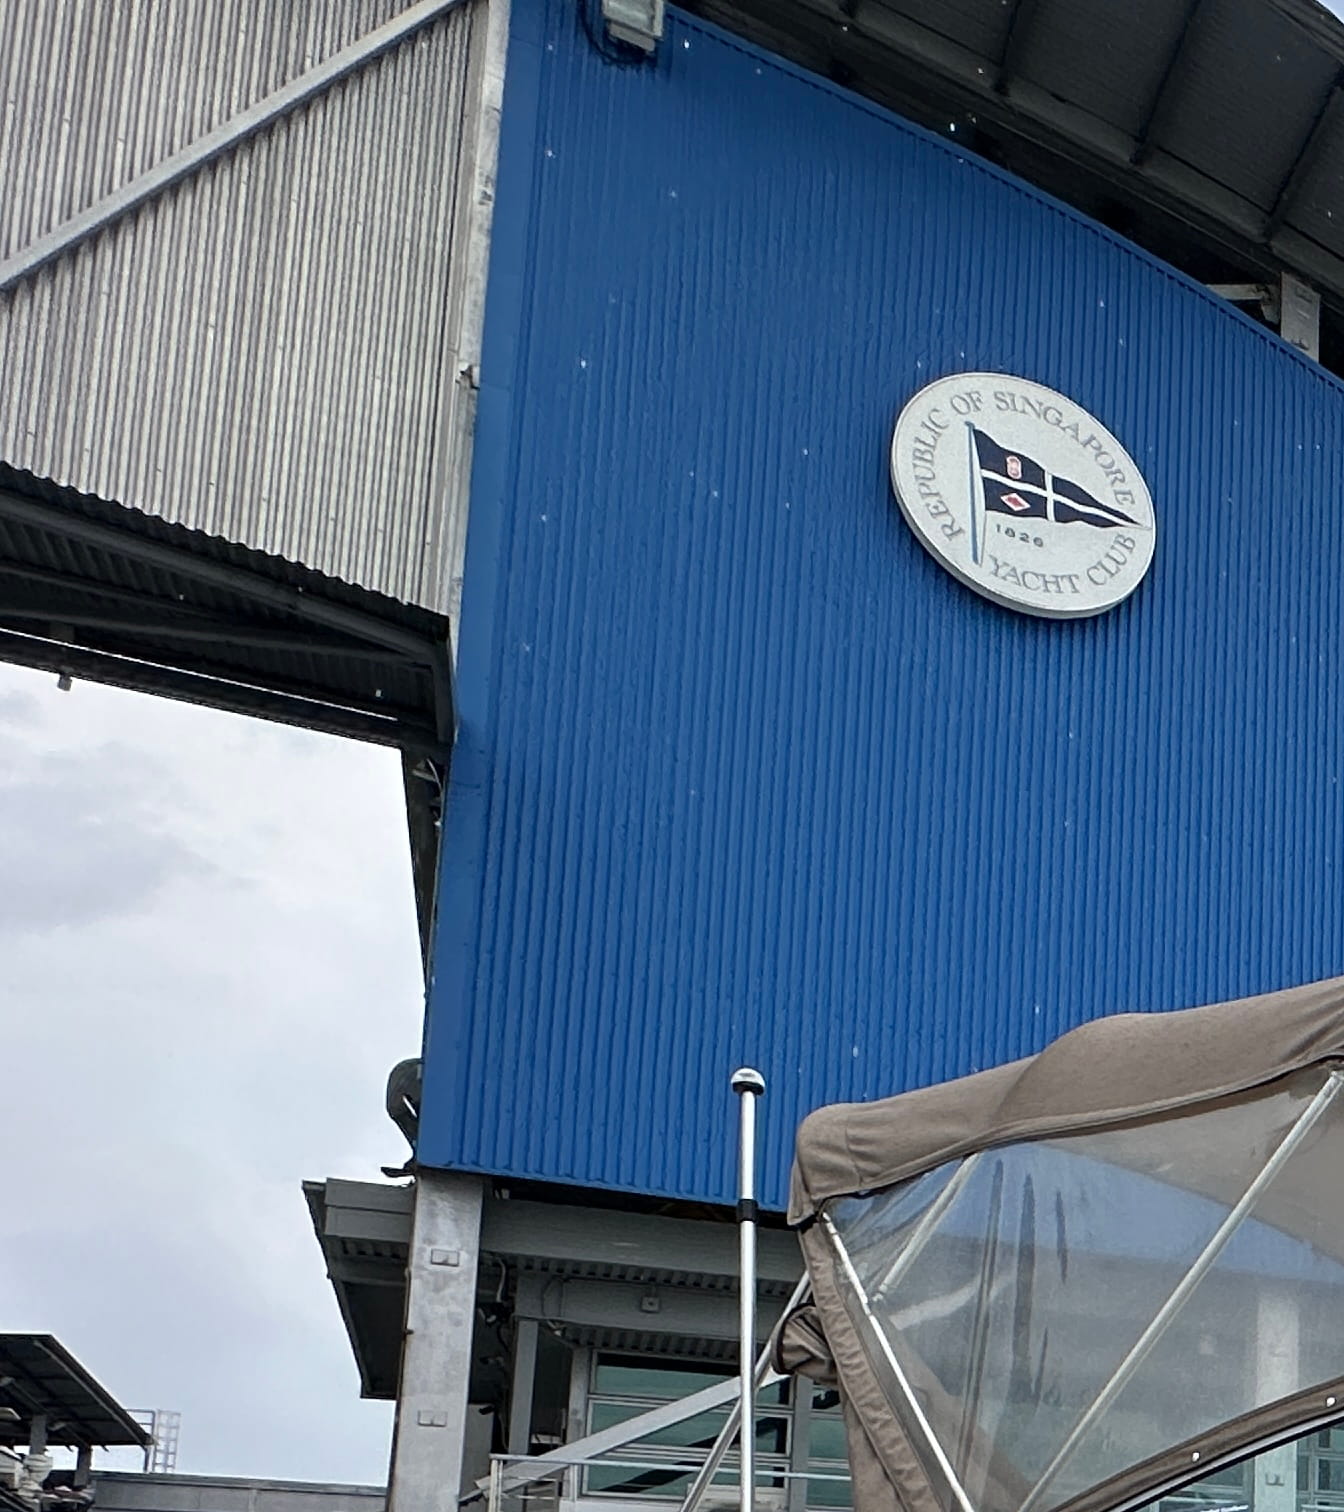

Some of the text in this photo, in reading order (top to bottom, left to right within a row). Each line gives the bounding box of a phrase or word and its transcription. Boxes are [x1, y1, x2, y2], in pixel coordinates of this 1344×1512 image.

[912, 391, 1135, 541] REPUBLIC OF SINGAPORE
[989, 533, 1137, 594] YACHT CLUB
